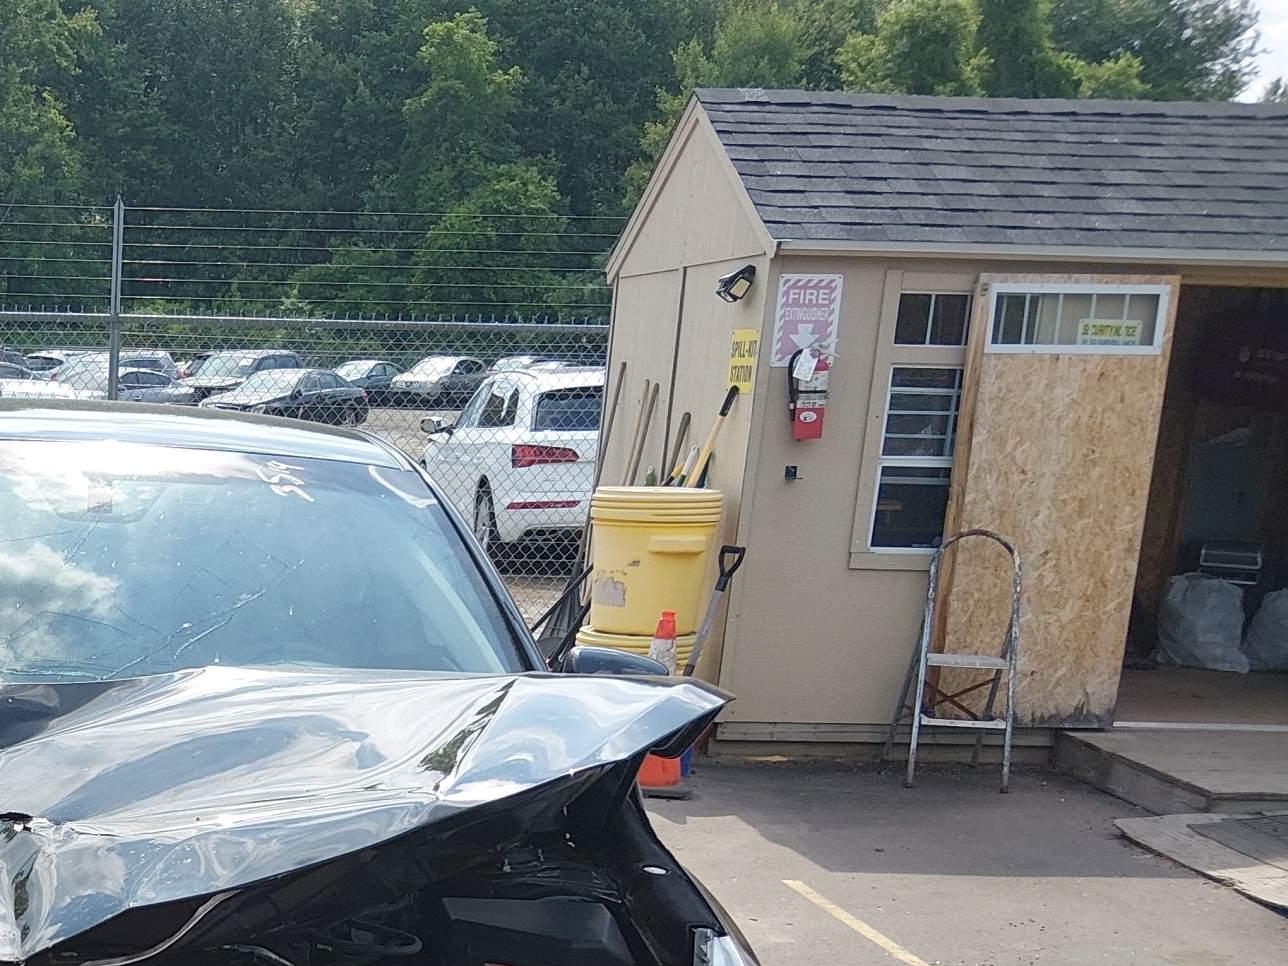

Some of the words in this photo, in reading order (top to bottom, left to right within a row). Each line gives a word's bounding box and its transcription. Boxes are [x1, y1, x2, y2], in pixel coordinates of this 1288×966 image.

[788, 289, 830, 305] FIRE
[784, 307, 830, 321] EXTINGUISHER
[730, 365, 753, 383] STATION
